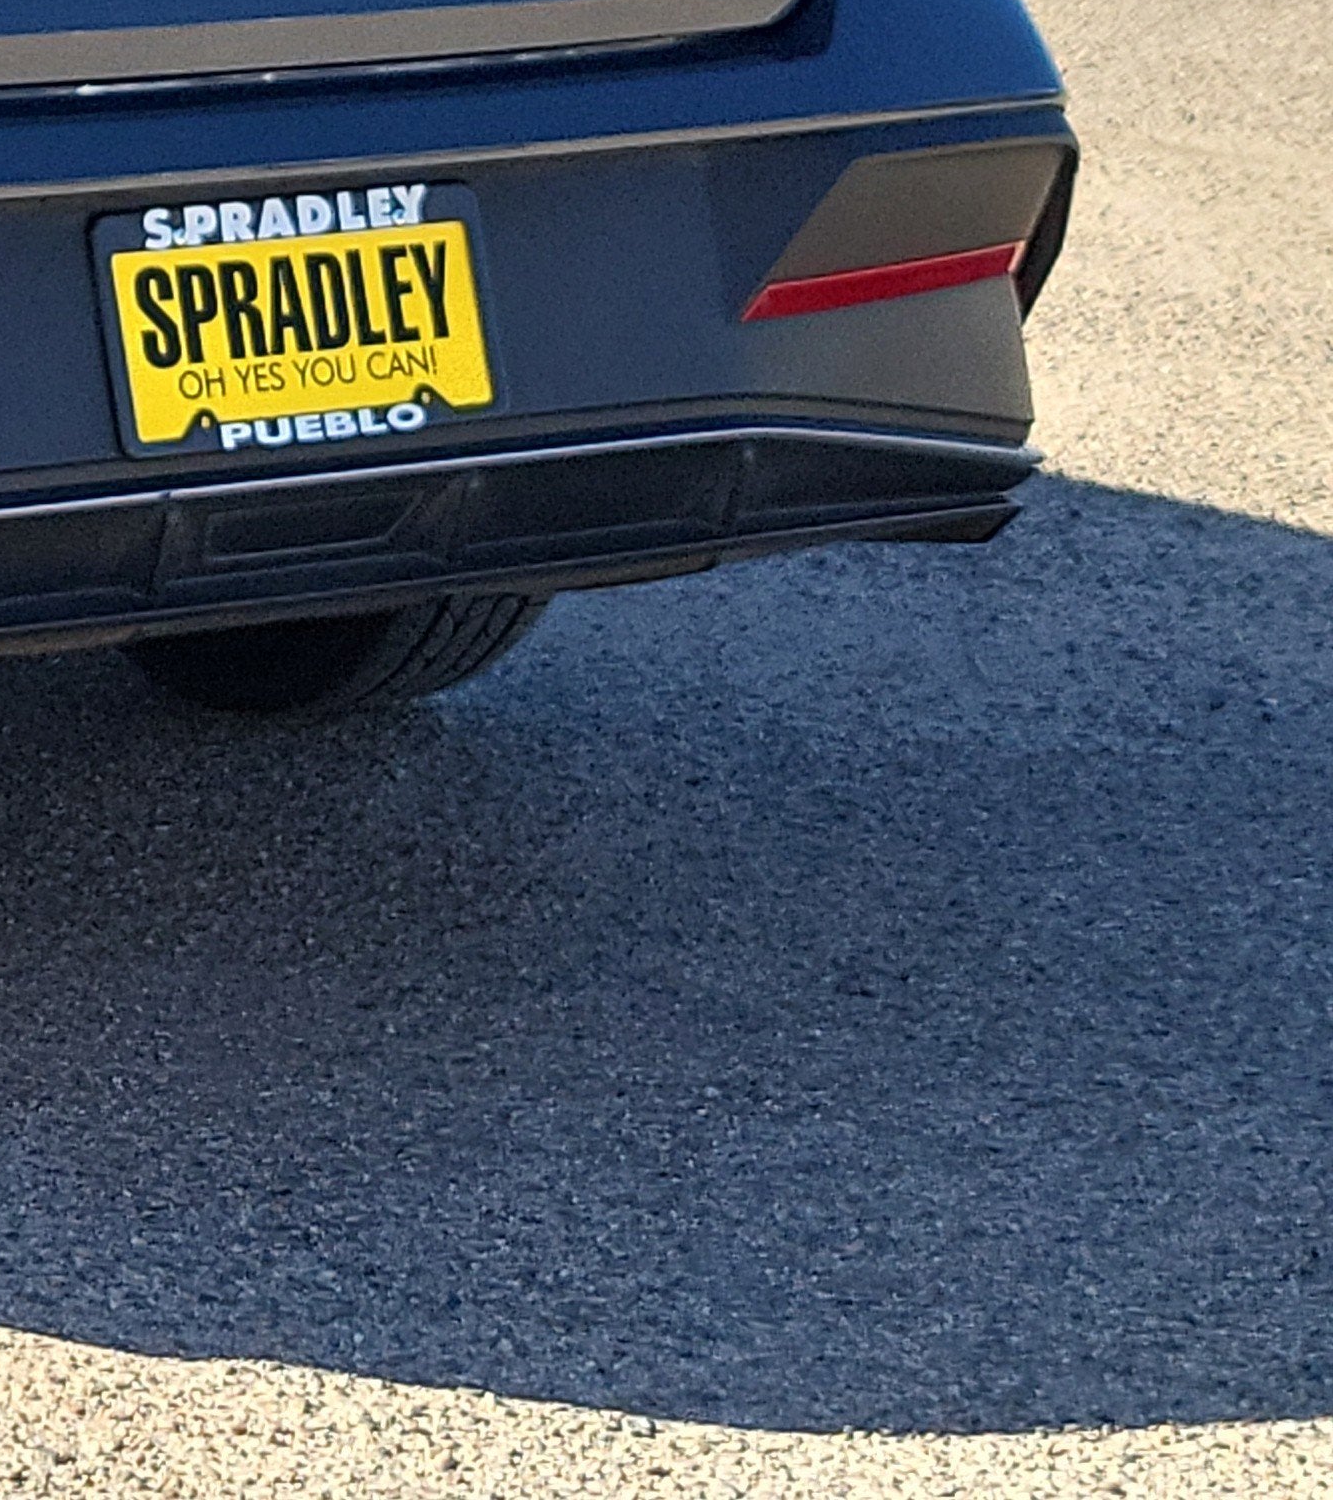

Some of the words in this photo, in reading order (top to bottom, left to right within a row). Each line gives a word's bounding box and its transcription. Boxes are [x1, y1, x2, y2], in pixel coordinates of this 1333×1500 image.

[142, 183, 426, 250] SPRADLEY
[134, 239, 451, 369] SPRADLEY
[178, 368, 227, 400] OH
[235, 361, 285, 395] YES
[291, 354, 359, 387] YOU
[366, 345, 439, 380] CAN!
[219, 402, 428, 450] PUEBLO
